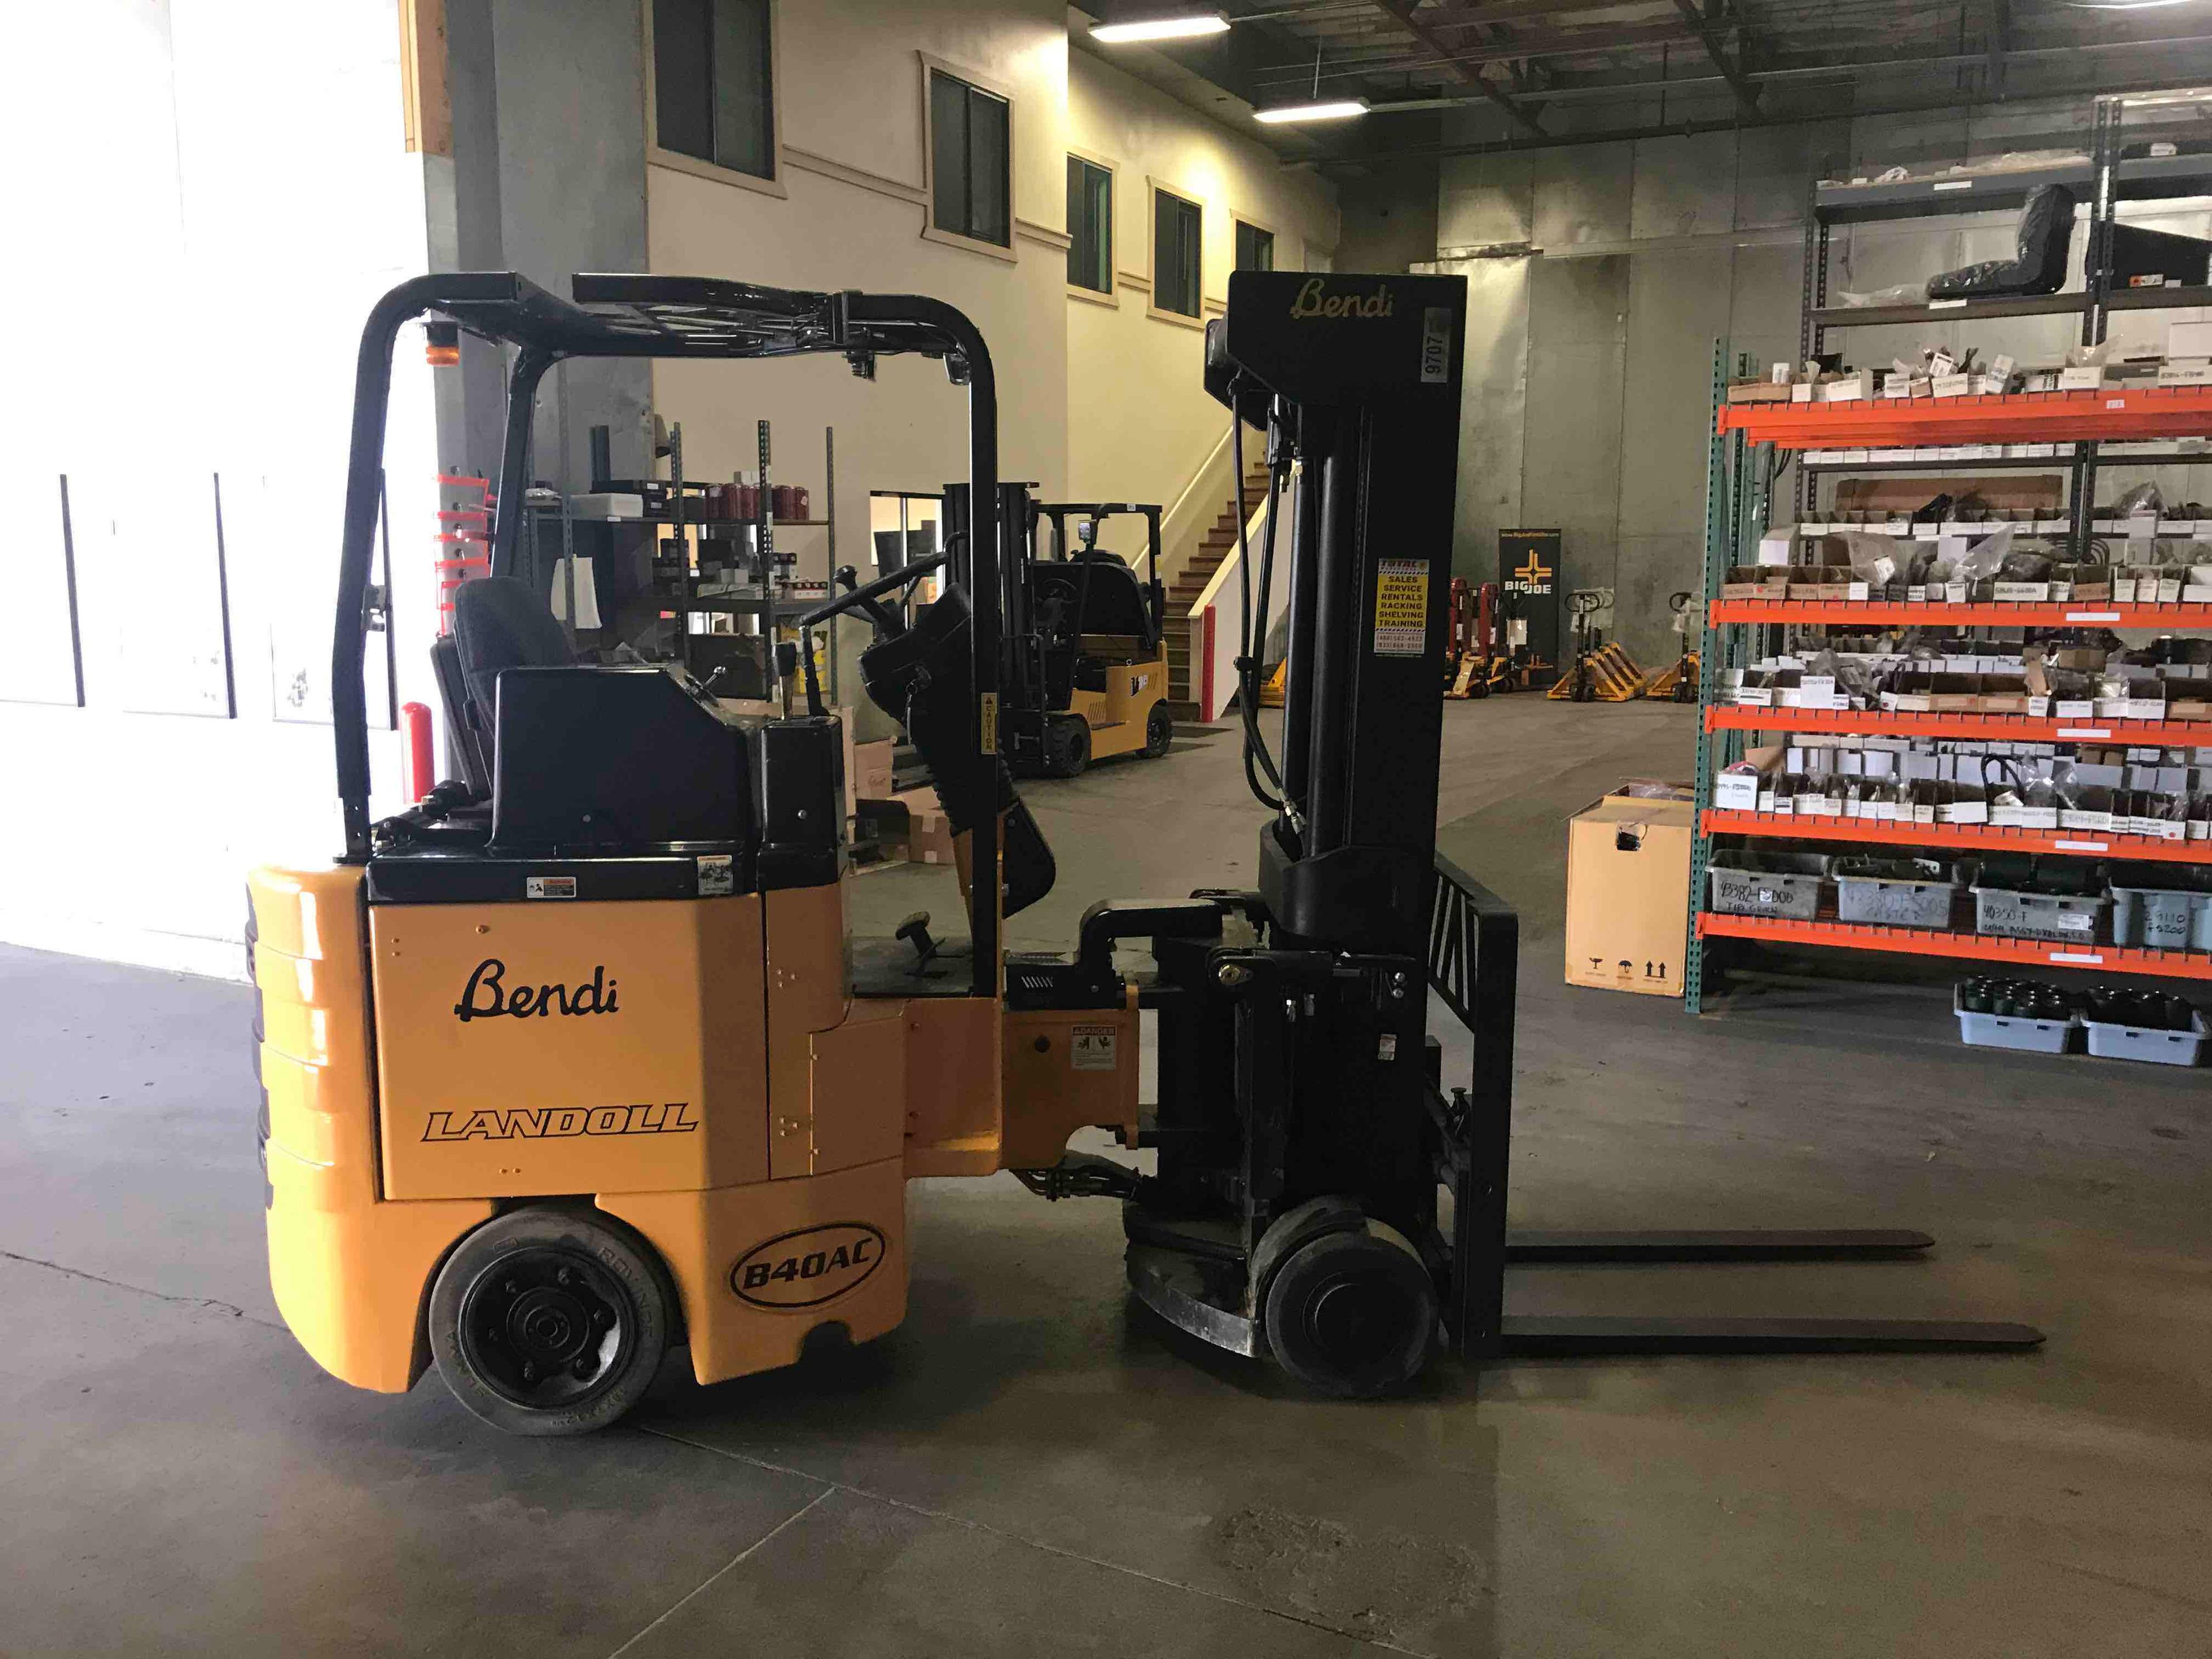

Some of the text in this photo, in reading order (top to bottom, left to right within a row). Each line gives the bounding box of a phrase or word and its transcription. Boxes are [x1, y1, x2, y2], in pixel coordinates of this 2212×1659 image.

[1290, 278, 1395, 319] Bendi
[1425, 336, 1444, 374] 9707
[1504, 581, 1552, 594] BIG JOE
[1378, 619, 1423, 627] TRAINING
[453, 959, 620, 1022] Bendi
[419, 1103, 699, 1142] LANDOLL
[743, 1236, 874, 1289] B40AC
